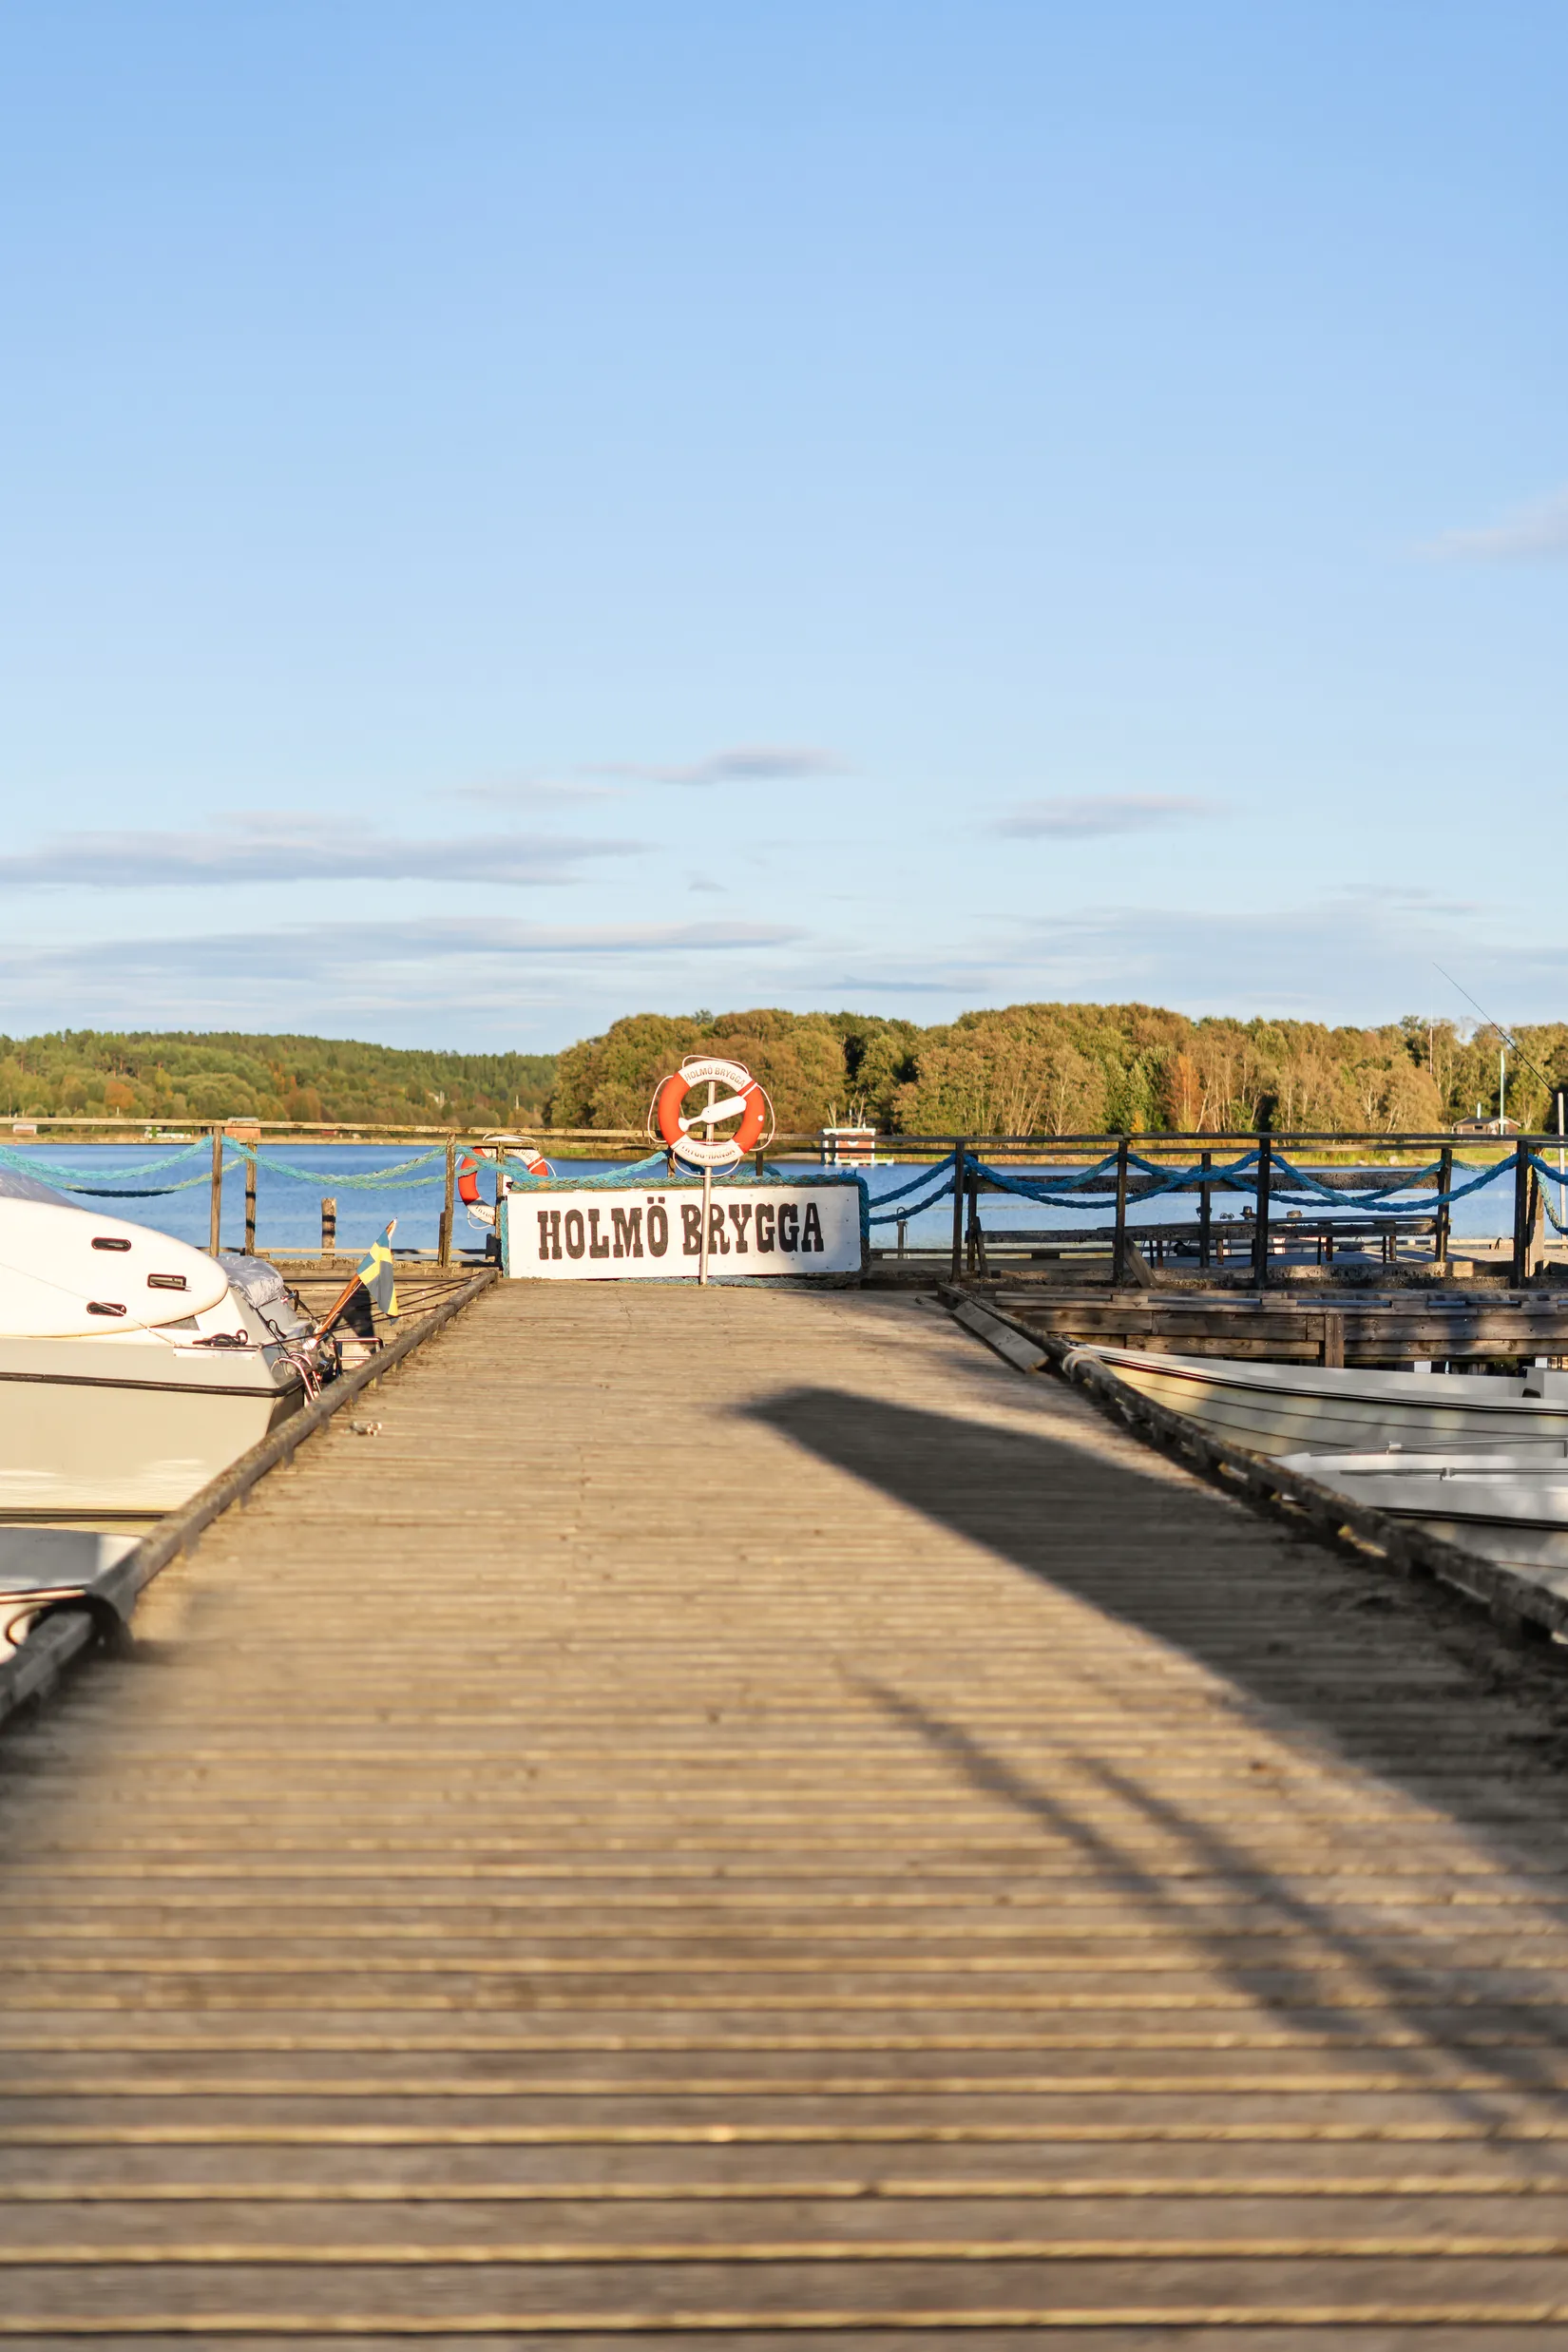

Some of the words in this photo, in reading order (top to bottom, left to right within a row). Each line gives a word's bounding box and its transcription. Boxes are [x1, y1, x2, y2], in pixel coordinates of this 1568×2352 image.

[684, 1064, 713, 1081] HOLMÖ
[715, 1066, 746, 1087] BRYGGA
[537, 1196, 669, 1260] HOLMÖ
[680, 1203, 825, 1255] BRYGGA
